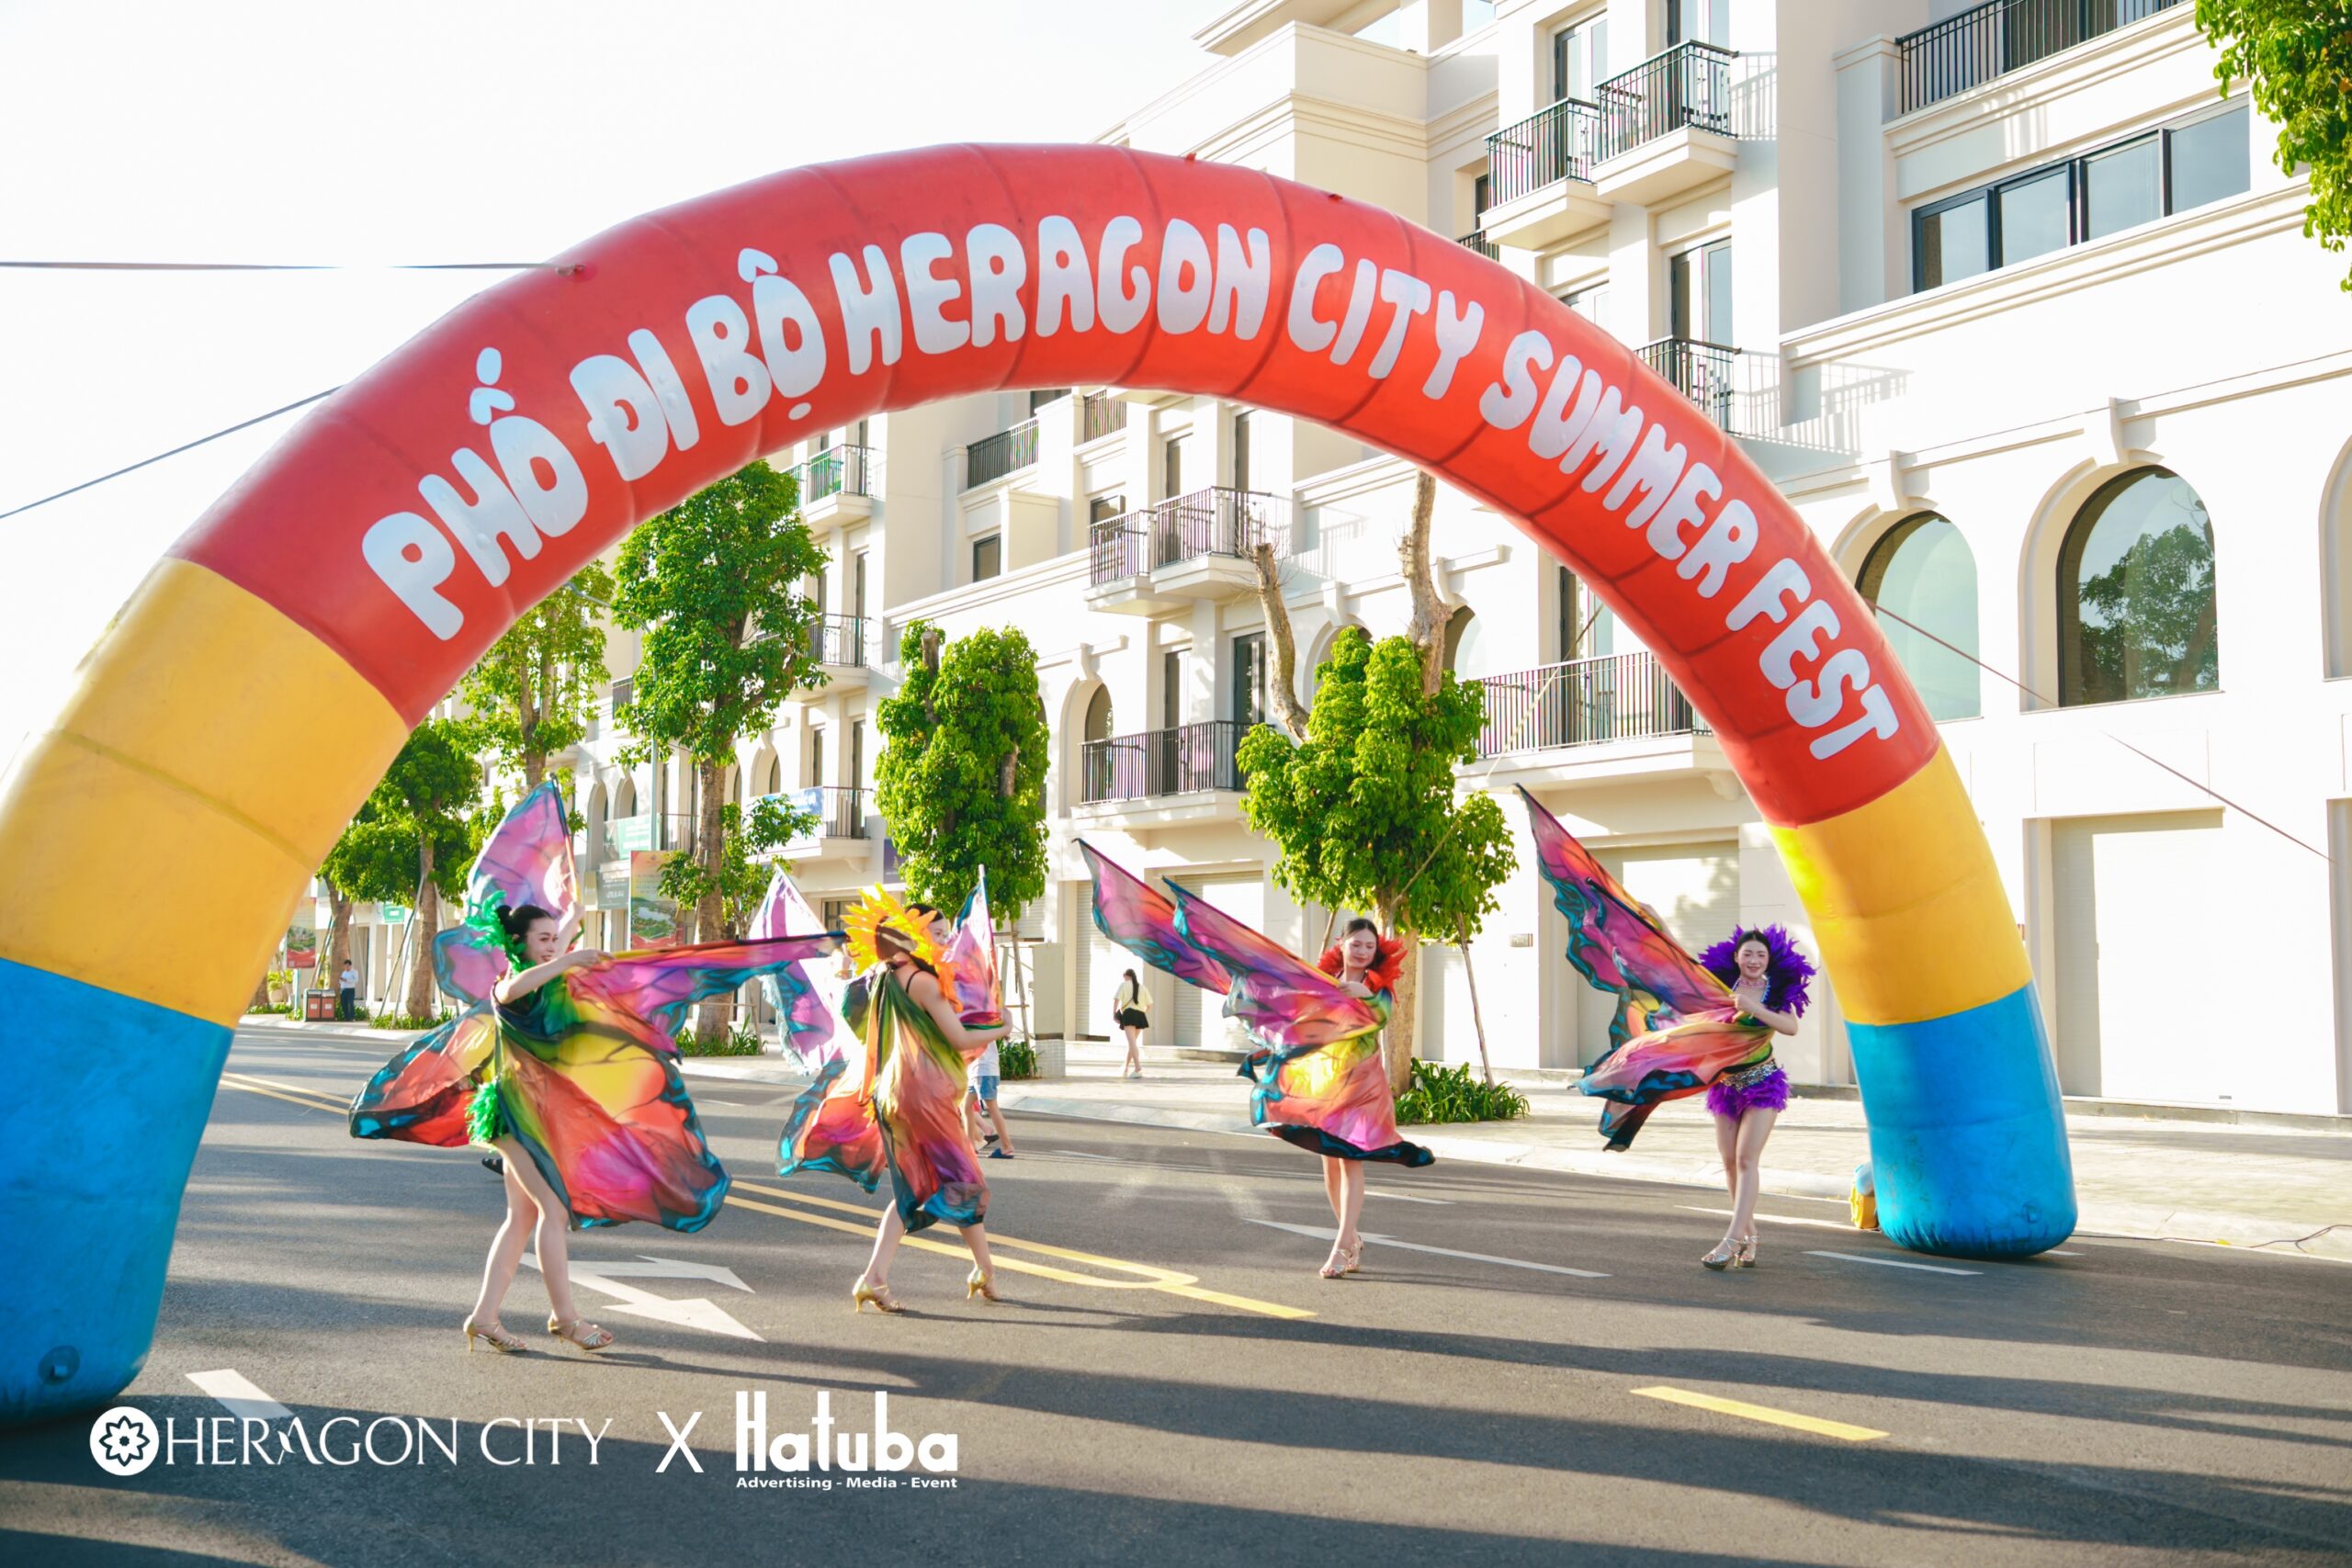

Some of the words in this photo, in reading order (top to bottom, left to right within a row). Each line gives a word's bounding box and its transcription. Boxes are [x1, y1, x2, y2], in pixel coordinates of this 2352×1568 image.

[362, 347, 588, 640] PHỐ
[570, 329, 699, 481] ĐI
[685, 248, 826, 426] BỘ
[829, 215, 1271, 375] HERAGON
[1287, 243, 1484, 400] CITY
[1479, 330, 1758, 598] SUMMER
[1726, 558, 1899, 760] FEST
